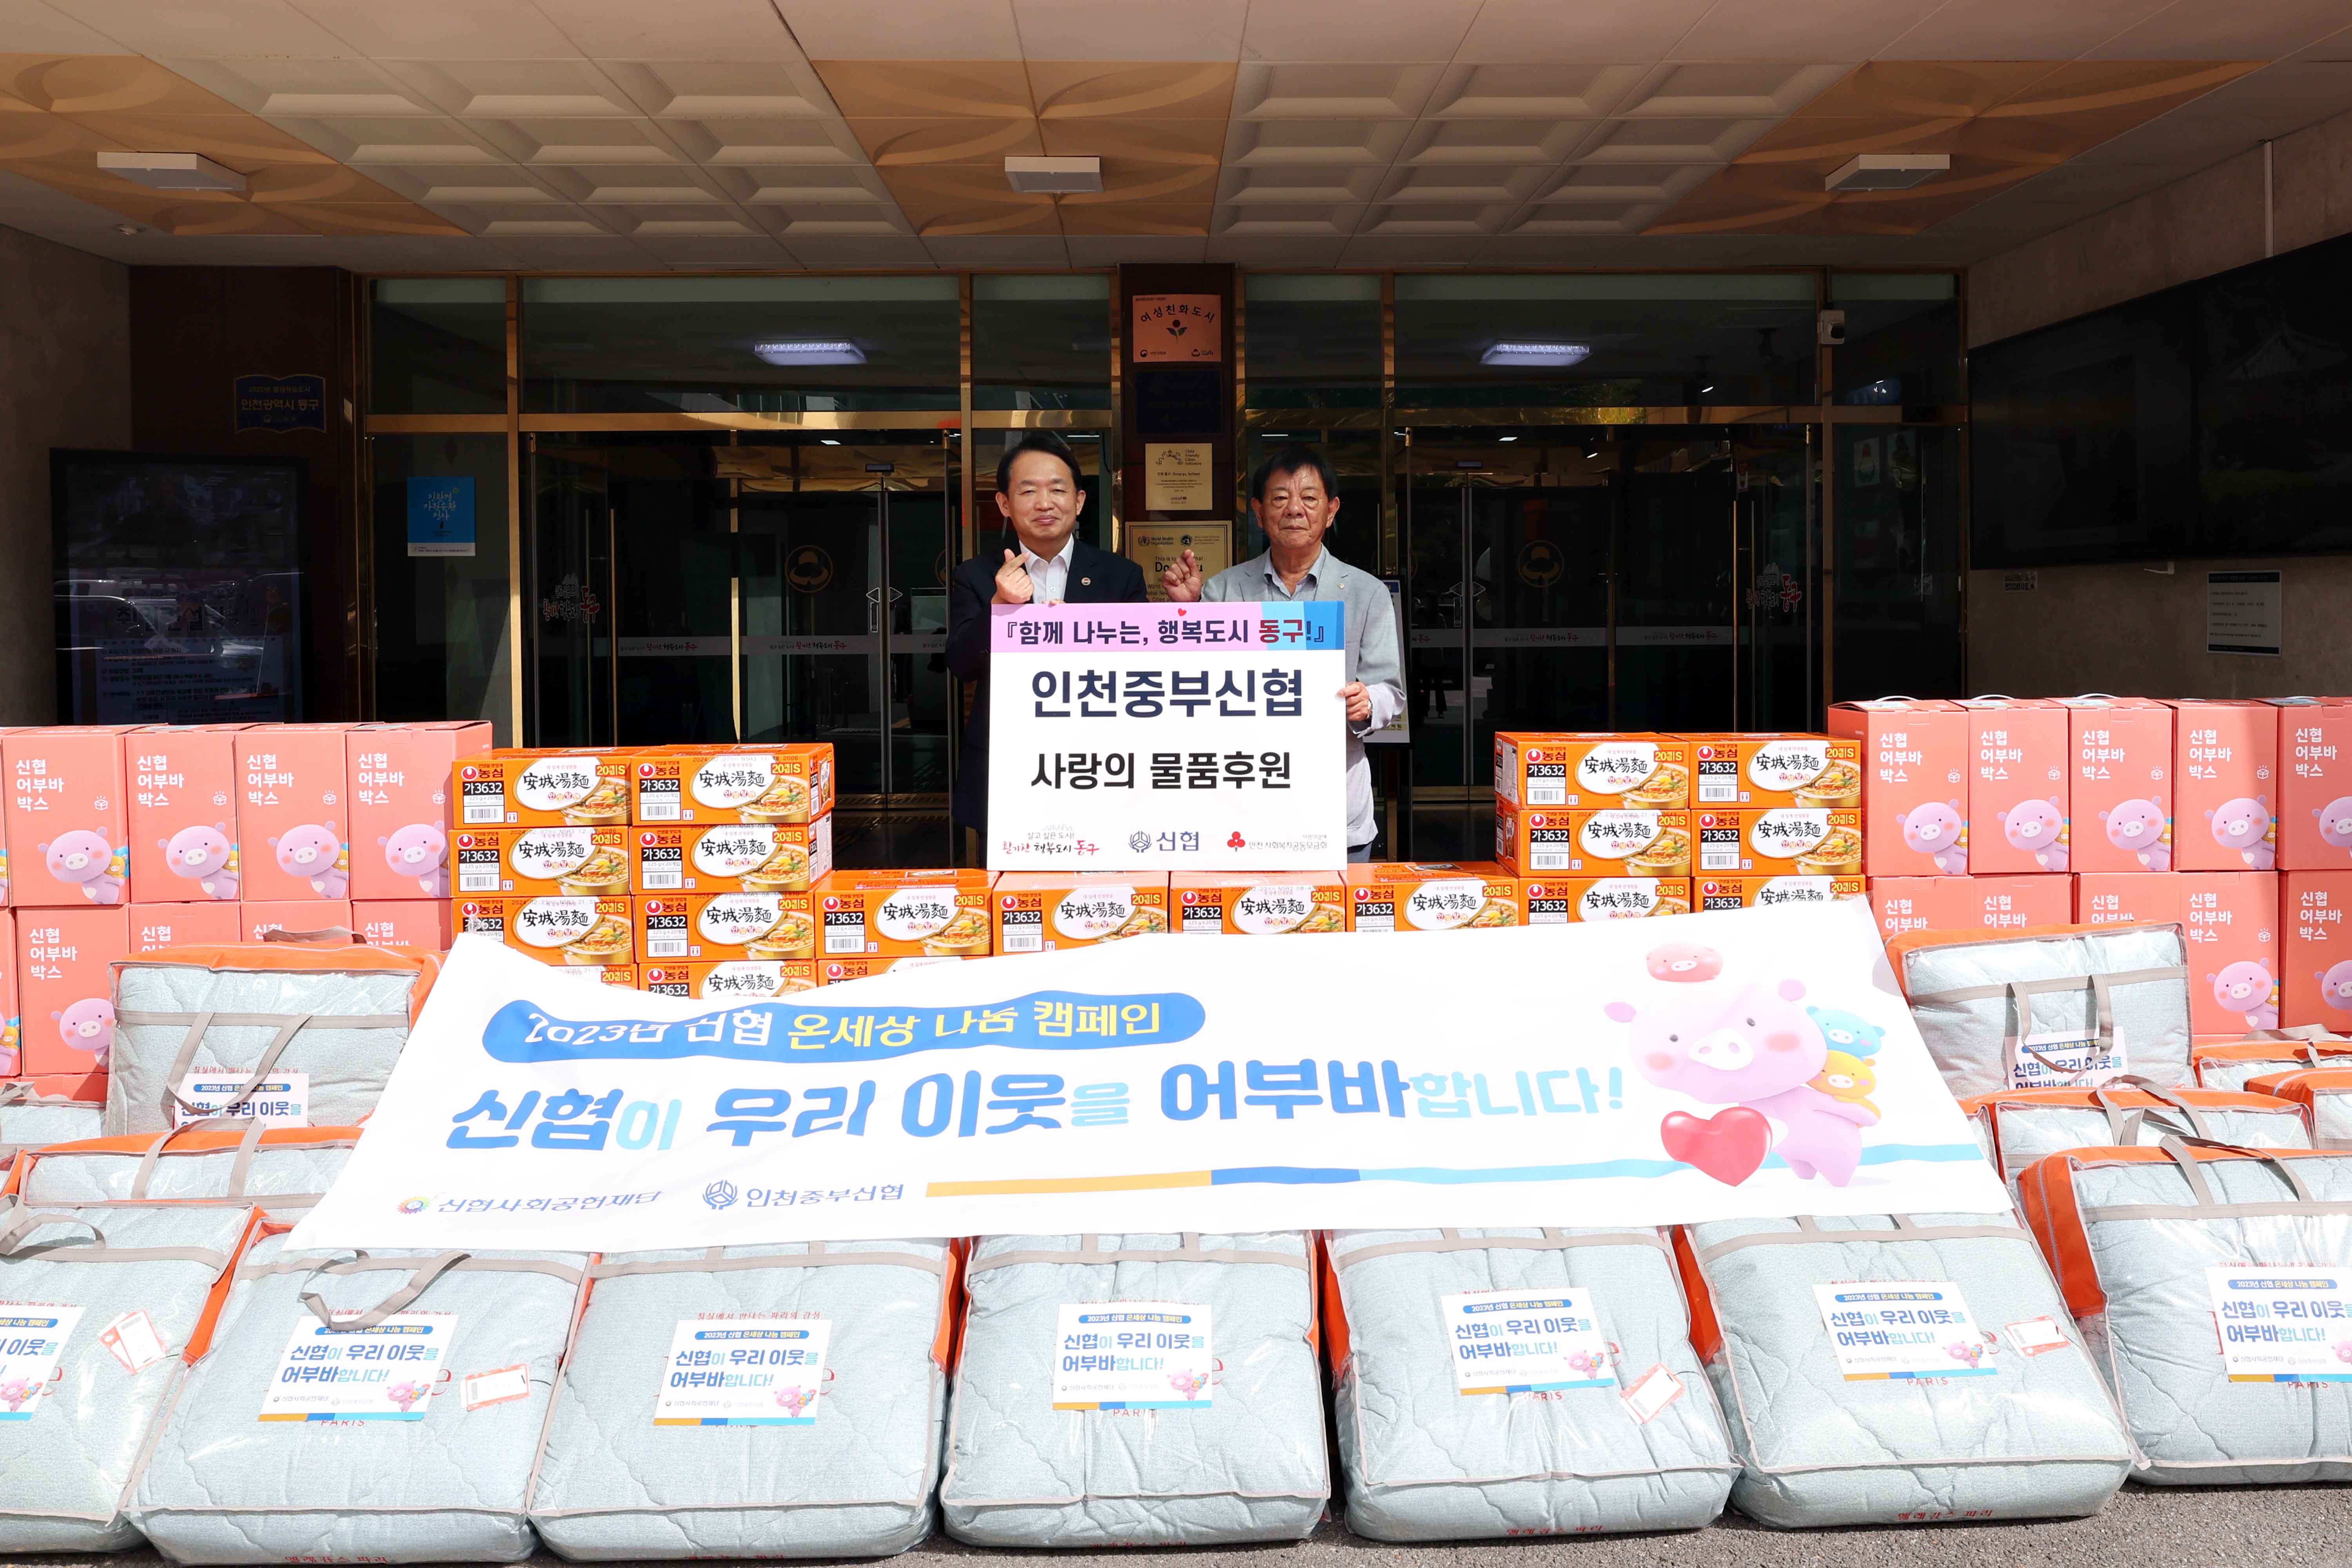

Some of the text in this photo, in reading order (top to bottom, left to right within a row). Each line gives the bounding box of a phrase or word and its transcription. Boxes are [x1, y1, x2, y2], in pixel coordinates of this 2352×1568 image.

[1141, 304, 1215, 323] 여성친화도시
[241, 399, 320, 411] 인천광역시 동구
[1074, 621, 1148, 646] 나누는,
[1158, 619, 1248, 644] 행복도시
[1032, 668, 1302, 718] 인천중부신협
[1880, 733, 1907, 748] 신협
[2083, 730, 2109, 745] 신협
[2296, 728, 2322, 743] 신협
[358, 753, 387, 769] 신협
[1543, 751, 1566, 761] 농심
[1715, 749, 1737, 758] 농심
[1880, 751, 1922, 765] 어부바
[2082, 748, 2125, 762] 어부바
[2296, 746, 2337, 760] 어부바
[16, 759, 46, 775] 신협
[137, 755, 167, 771] 신협
[247, 754, 277, 770] 신협
[1031, 750, 1291, 790] 사랑의 물품후원
[1586, 757, 1648, 774] 安城湯麵
[1700, 762, 1736, 773] 가3632
[1757, 754, 1821, 771] 安城湯麵
[478, 769, 503, 779] 농심
[655, 766, 680, 775] 농심
[1529, 765, 1564, 776] 가3632
[1880, 769, 1907, 783] 박스
[2082, 766, 2111, 780] 박스
[2296, 763, 2323, 778] 박스
[16, 778, 64, 793] 어부바
[138, 773, 184, 789] 어부바
[247, 772, 294, 788] 어부바
[358, 771, 405, 787] 어부바
[524, 773, 589, 790] 安城湯麵
[641, 780, 679, 791] 가3632
[700, 770, 765, 788] 安城湯麵
[359, 789, 389, 805] 박스
[465, 783, 502, 795] 가3632
[17, 796, 49, 812] 박스
[138, 792, 169, 808] 박스
[248, 791, 279, 806] 박스
[702, 838, 767, 856] 安城湯麵
[1034, 842, 1071, 855] 행복도시
[1074, 840, 1100, 856] 동구
[1156, 831, 1199, 851] 신협
[1265, 841, 1327, 852] 사회복지공동모금회
[643, 849, 680, 860] 가3632
[840, 899, 864, 909] 농심
[1018, 898, 1042, 907] 농심
[1198, 893, 1221, 903] 농심
[1414, 894, 1478, 911] 安城湯麵
[1984, 895, 2011, 911] 신협
[2190, 893, 2217, 908] 신협
[884, 903, 949, 920] 安城湯麵
[1062, 902, 1126, 919] 安城湯麵
[1184, 907, 1221, 918] 가3632
[1241, 898, 1307, 915] 安城湯麵
[1357, 904, 1393, 915] 가3632
[648, 916, 686, 928] 가3632
[707, 907, 773, 924] 安城湯麵
[826, 913, 863, 924] 가3632
[1004, 912, 1041, 923] 가3632
[1984, 914, 2027, 928] 어부바
[2190, 910, 2232, 925] 어부바
[29, 928, 60, 944] 신협
[365, 922, 394, 938] 신협
[2190, 928, 2218, 943] 박스
[30, 946, 78, 962] 어부바
[31, 965, 62, 980] 박스
[525, 1001, 1160, 1050] 2023년 신협 온세상 나눔 캠페인
[446, 1058, 1623, 1151] 신협이 우리 이웃을 어부바합니다!
[438, 1184, 904, 1213] 신협사회공헌재단 인천중부신협
[1455, 1317, 1592, 1339] 신협이 우리 이웃을
[1837, 1330, 1936, 1347] 어부바합니다!
[7, 1339, 58, 1356] 이웃을
[290, 1345, 439, 1361] 신협이 우리 이웃을
[1460, 1342, 1558, 1359] 어부바합니다!
[676, 1350, 819, 1367] 신협이 우리 이웃을
[282, 1366, 390, 1383] 어부바합니다!
[670, 1372, 774, 1388] 어부바합니다!
[1907, 1377, 1949, 1386] PARIS
